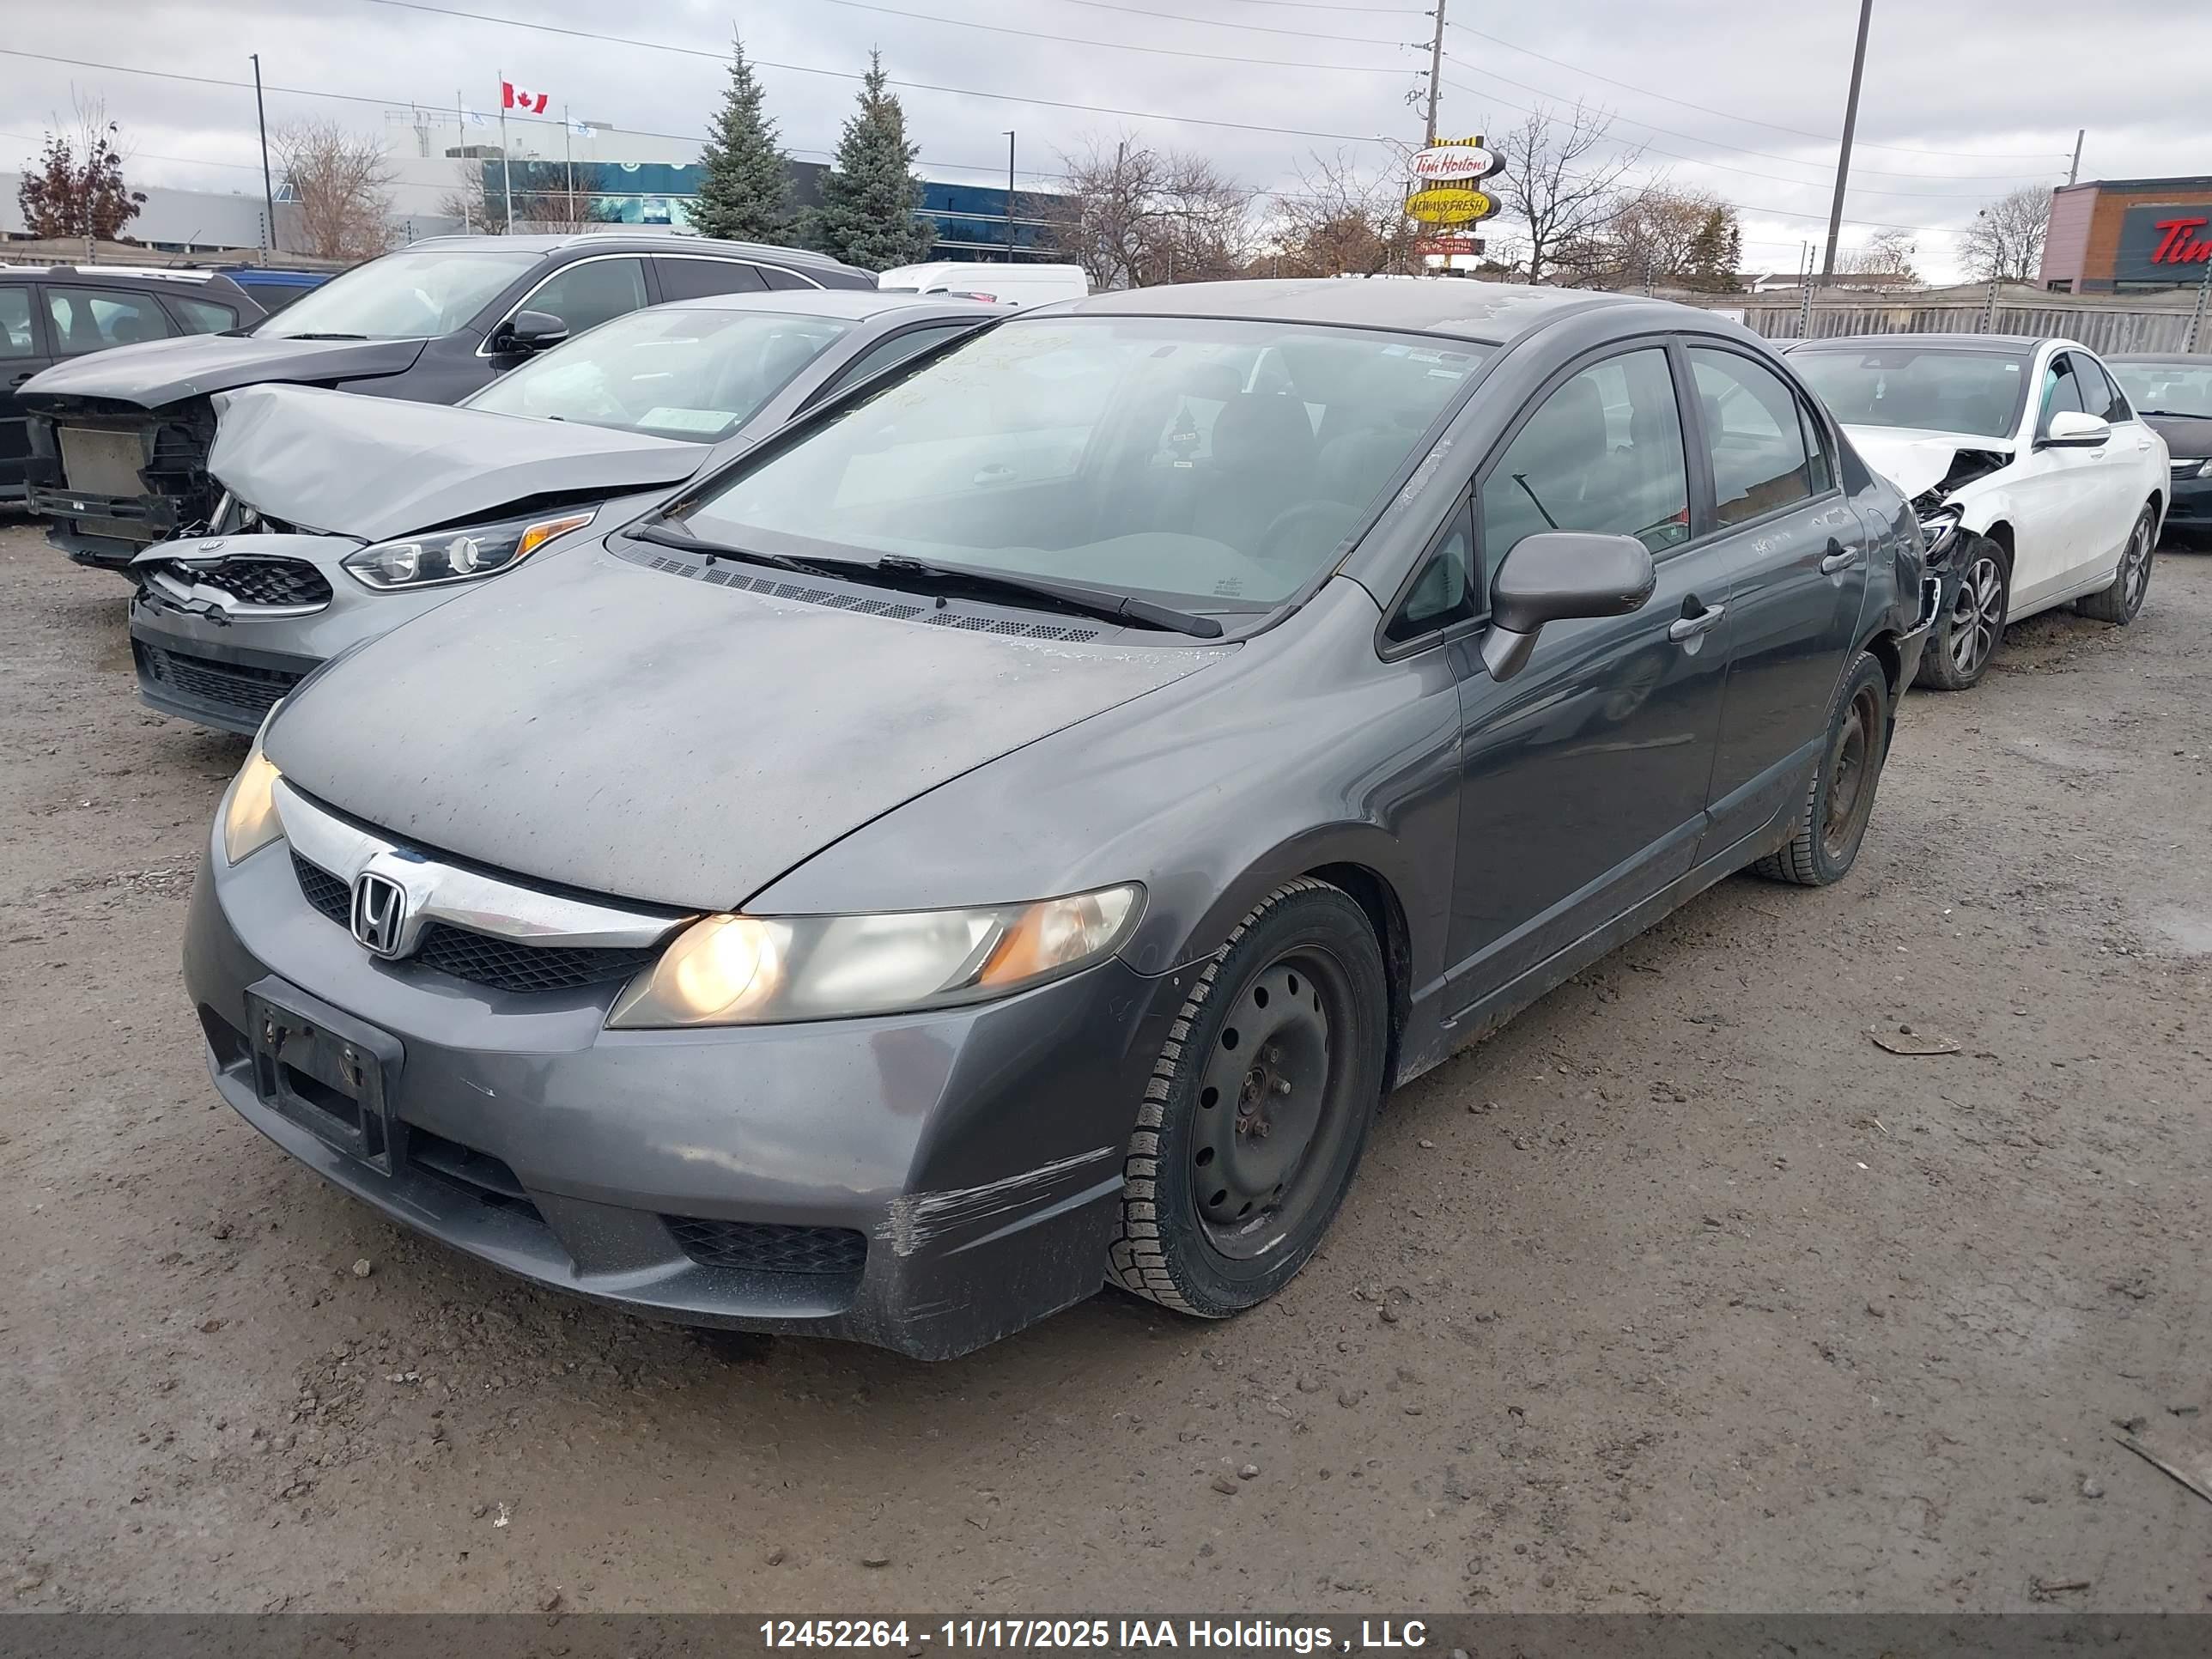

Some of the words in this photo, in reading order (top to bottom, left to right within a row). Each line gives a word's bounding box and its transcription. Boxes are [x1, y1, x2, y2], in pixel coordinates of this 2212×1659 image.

[1416, 154, 1439, 173] Tim
[1440, 153, 1486, 173] Hortons
[1449, 198, 1484, 212] FRESH
